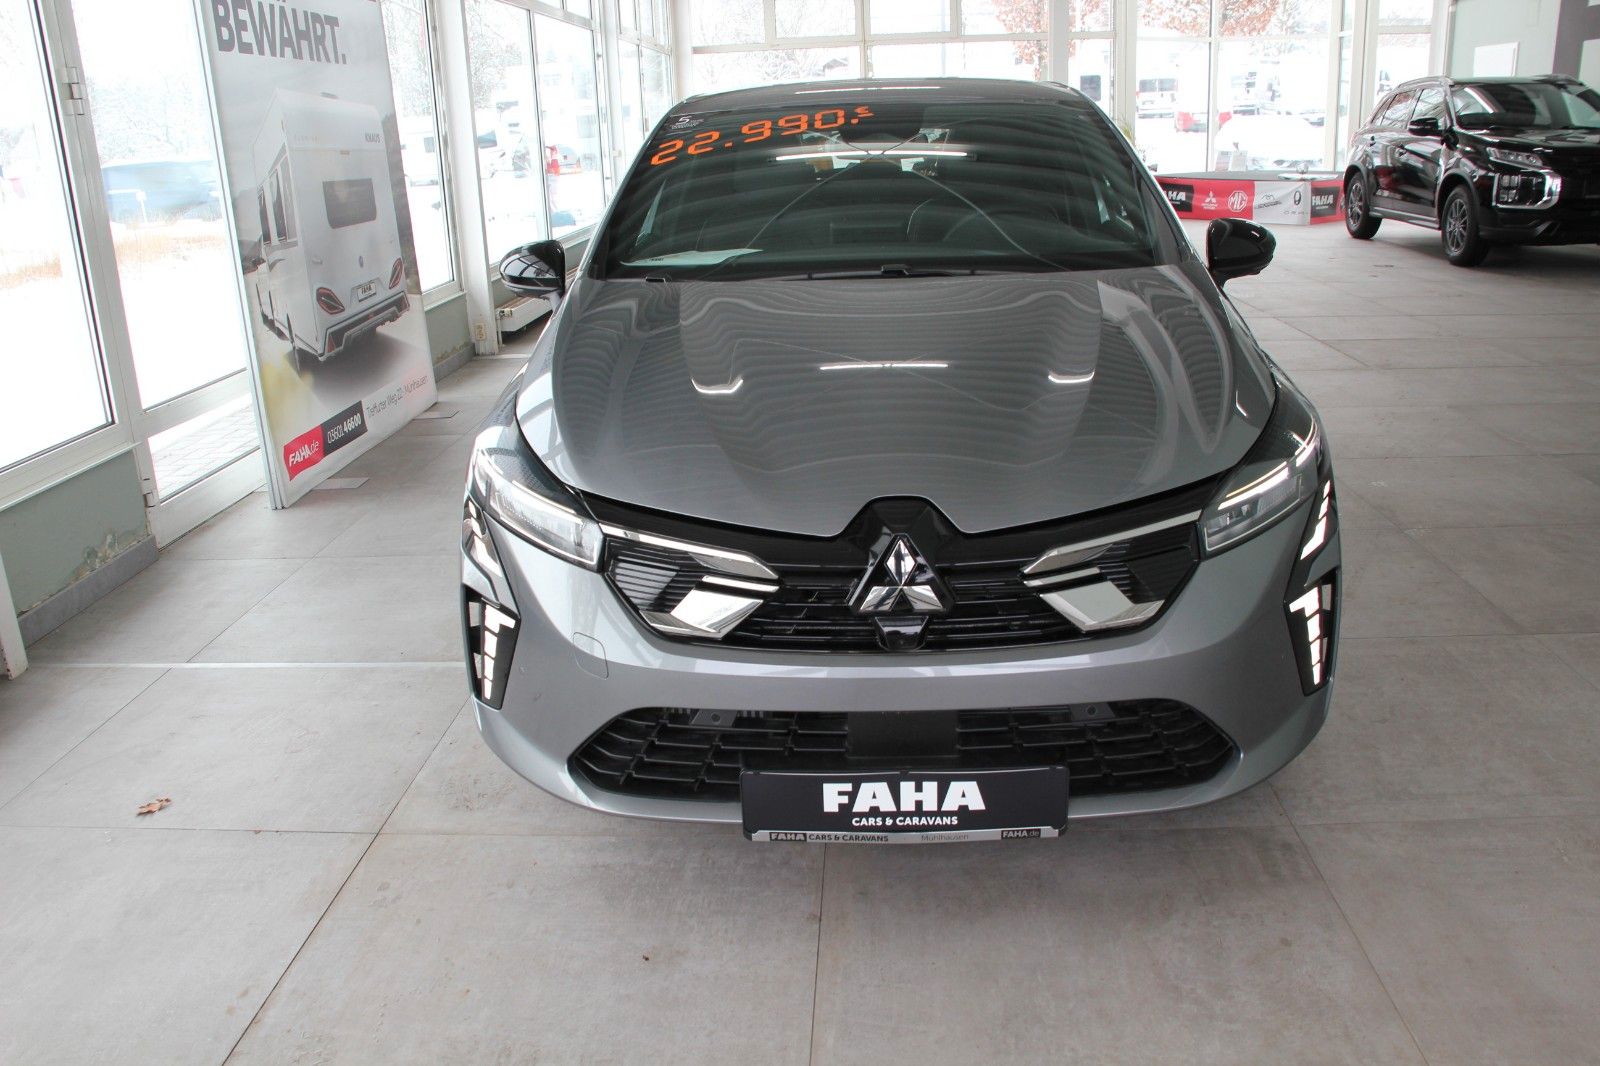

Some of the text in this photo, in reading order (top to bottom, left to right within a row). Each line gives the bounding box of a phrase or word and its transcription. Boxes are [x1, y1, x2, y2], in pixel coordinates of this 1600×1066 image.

[211, 0, 347, 65] BEWÄHRT.
[1229, 191, 1248, 212] MG
[288, 440, 320, 467] FAHA.de
[822, 781, 986, 813] FAHA
[852, 816, 958, 826] CARS & CARAVANS
[808, 833, 833, 841] CARS
[842, 834, 889, 842] CARAVANS
[1002, 830, 1040, 838] FAHA.de
